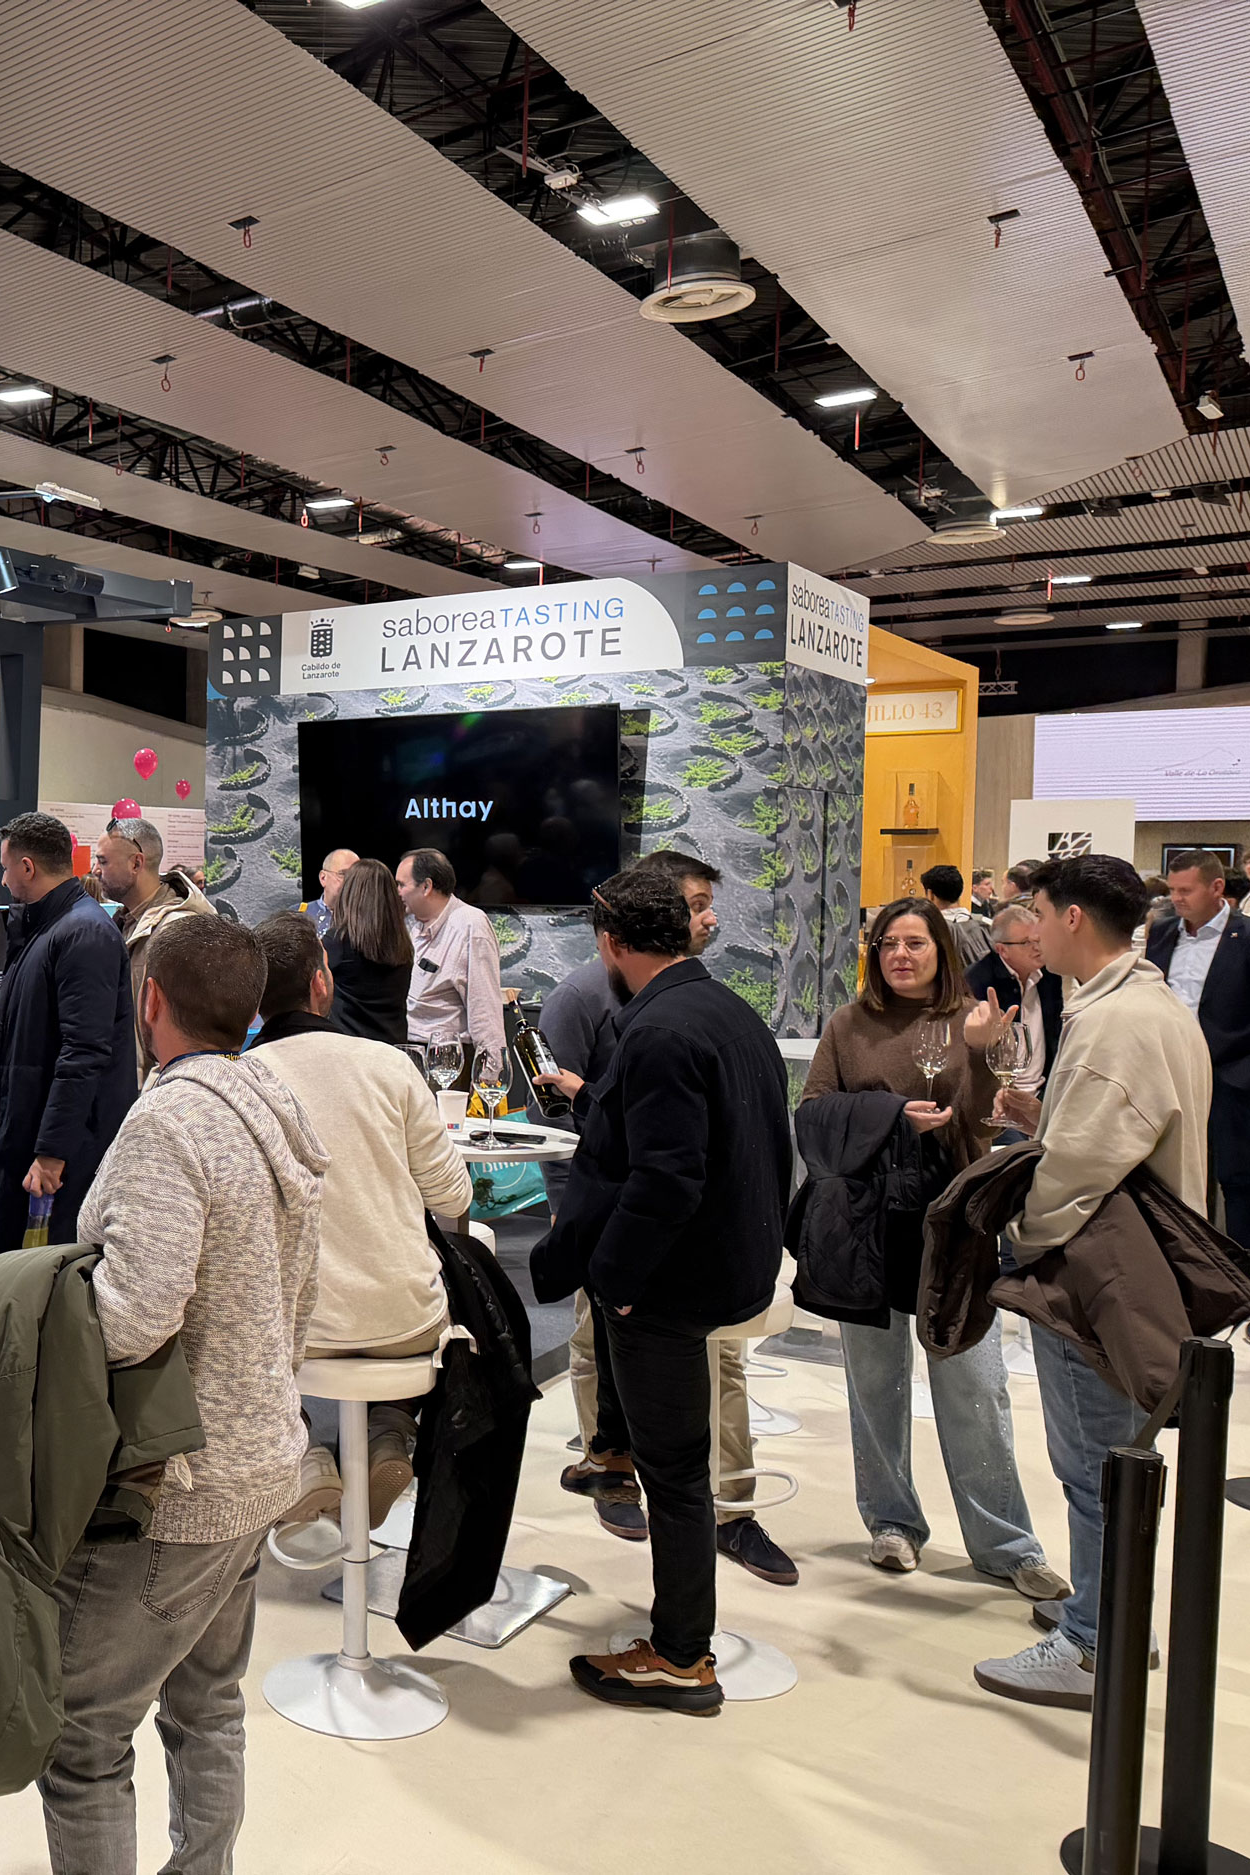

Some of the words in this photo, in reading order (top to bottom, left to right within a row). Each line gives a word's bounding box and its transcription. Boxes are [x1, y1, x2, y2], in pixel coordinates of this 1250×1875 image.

[380, 627, 623, 673] LANZAROTE
[791, 614, 862, 668] LANZAROTE
[301, 663, 330, 671] Cabildo
[331, 661, 341, 669] de
[302, 671, 340, 680] Lanzarote
[866, 703, 915, 724] JILLO
[919, 701, 943, 719] 43
[405, 797, 494, 822] Althay
